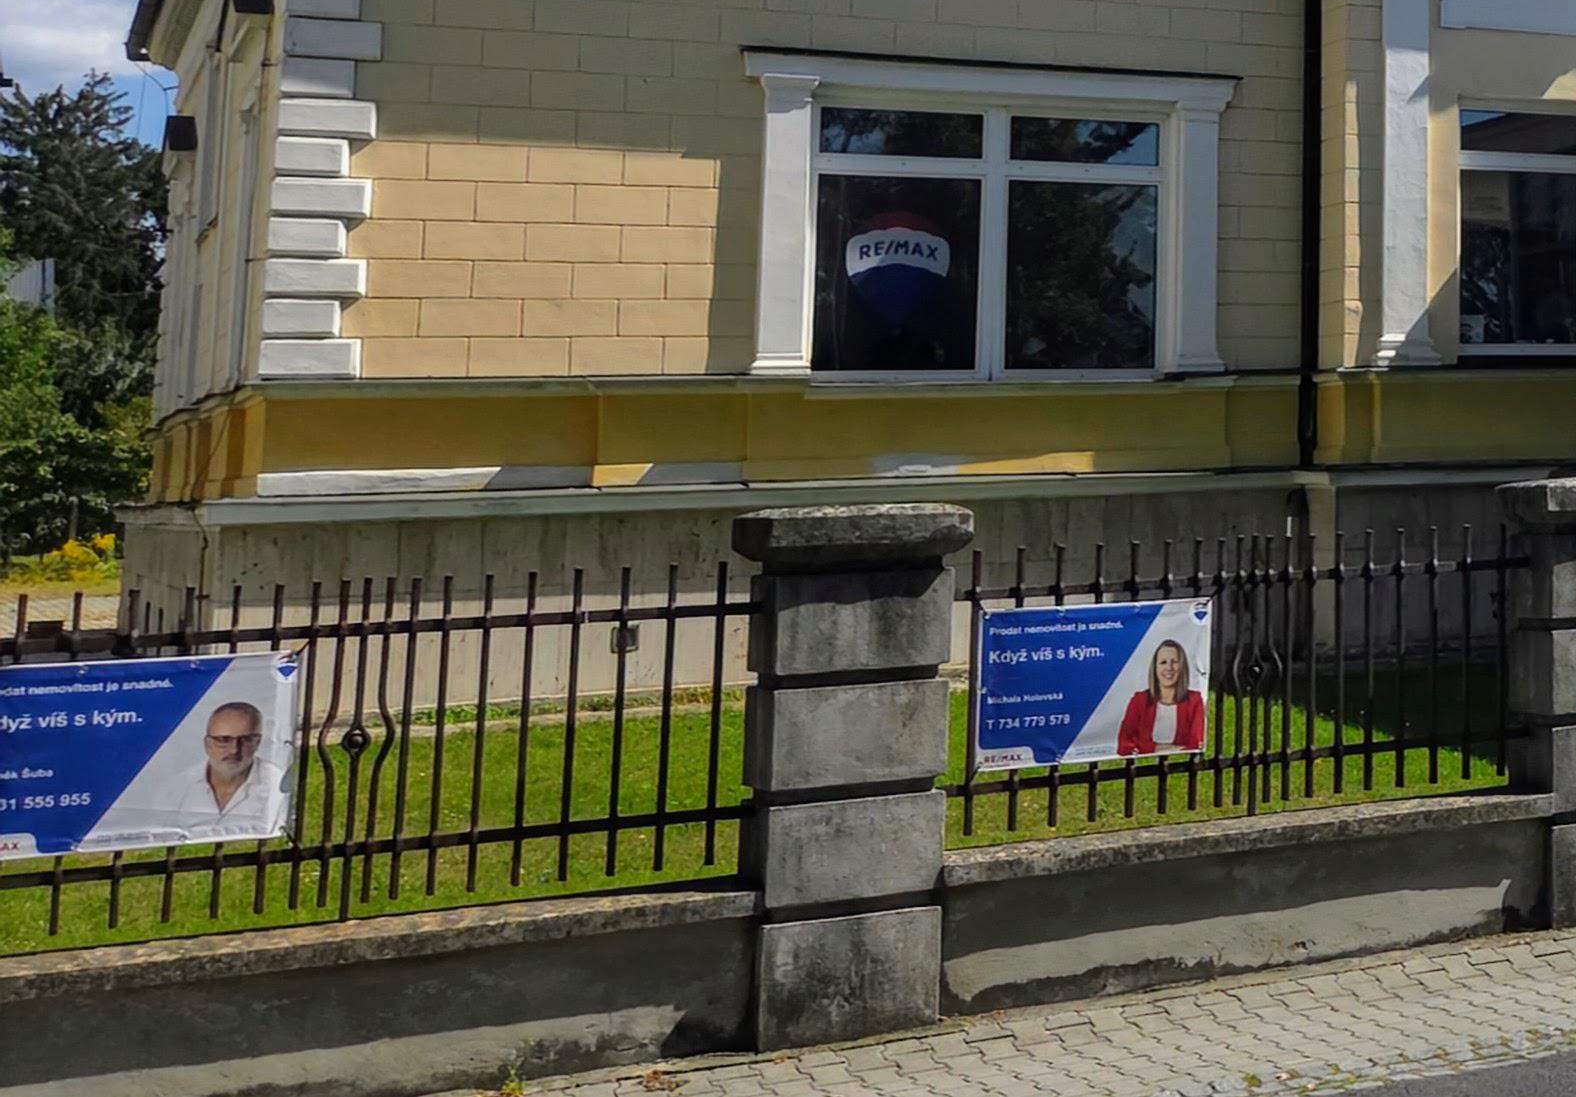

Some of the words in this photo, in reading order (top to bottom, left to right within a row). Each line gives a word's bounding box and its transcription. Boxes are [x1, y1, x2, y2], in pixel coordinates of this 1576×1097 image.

[859, 240, 939, 261] RE/MAX
[988, 648, 1028, 665] Když
[1031, 646, 1053, 661] víš
[1056, 648, 1065, 659] s
[1068, 645, 1104, 661] kým.
[28, 682, 103, 696] nemovitost
[105, 681, 119, 692] je
[122, 678, 174, 690] snadné.
[38, 710, 69, 728] víš
[74, 713, 87, 727] s
[92, 707, 144, 727] kým.
[986, 719, 995, 730] T
[998, 717, 1021, 730] 734
[1023, 715, 1046, 727] 779
[23, 794, 55, 810] 555
[59, 792, 91, 807] 955
